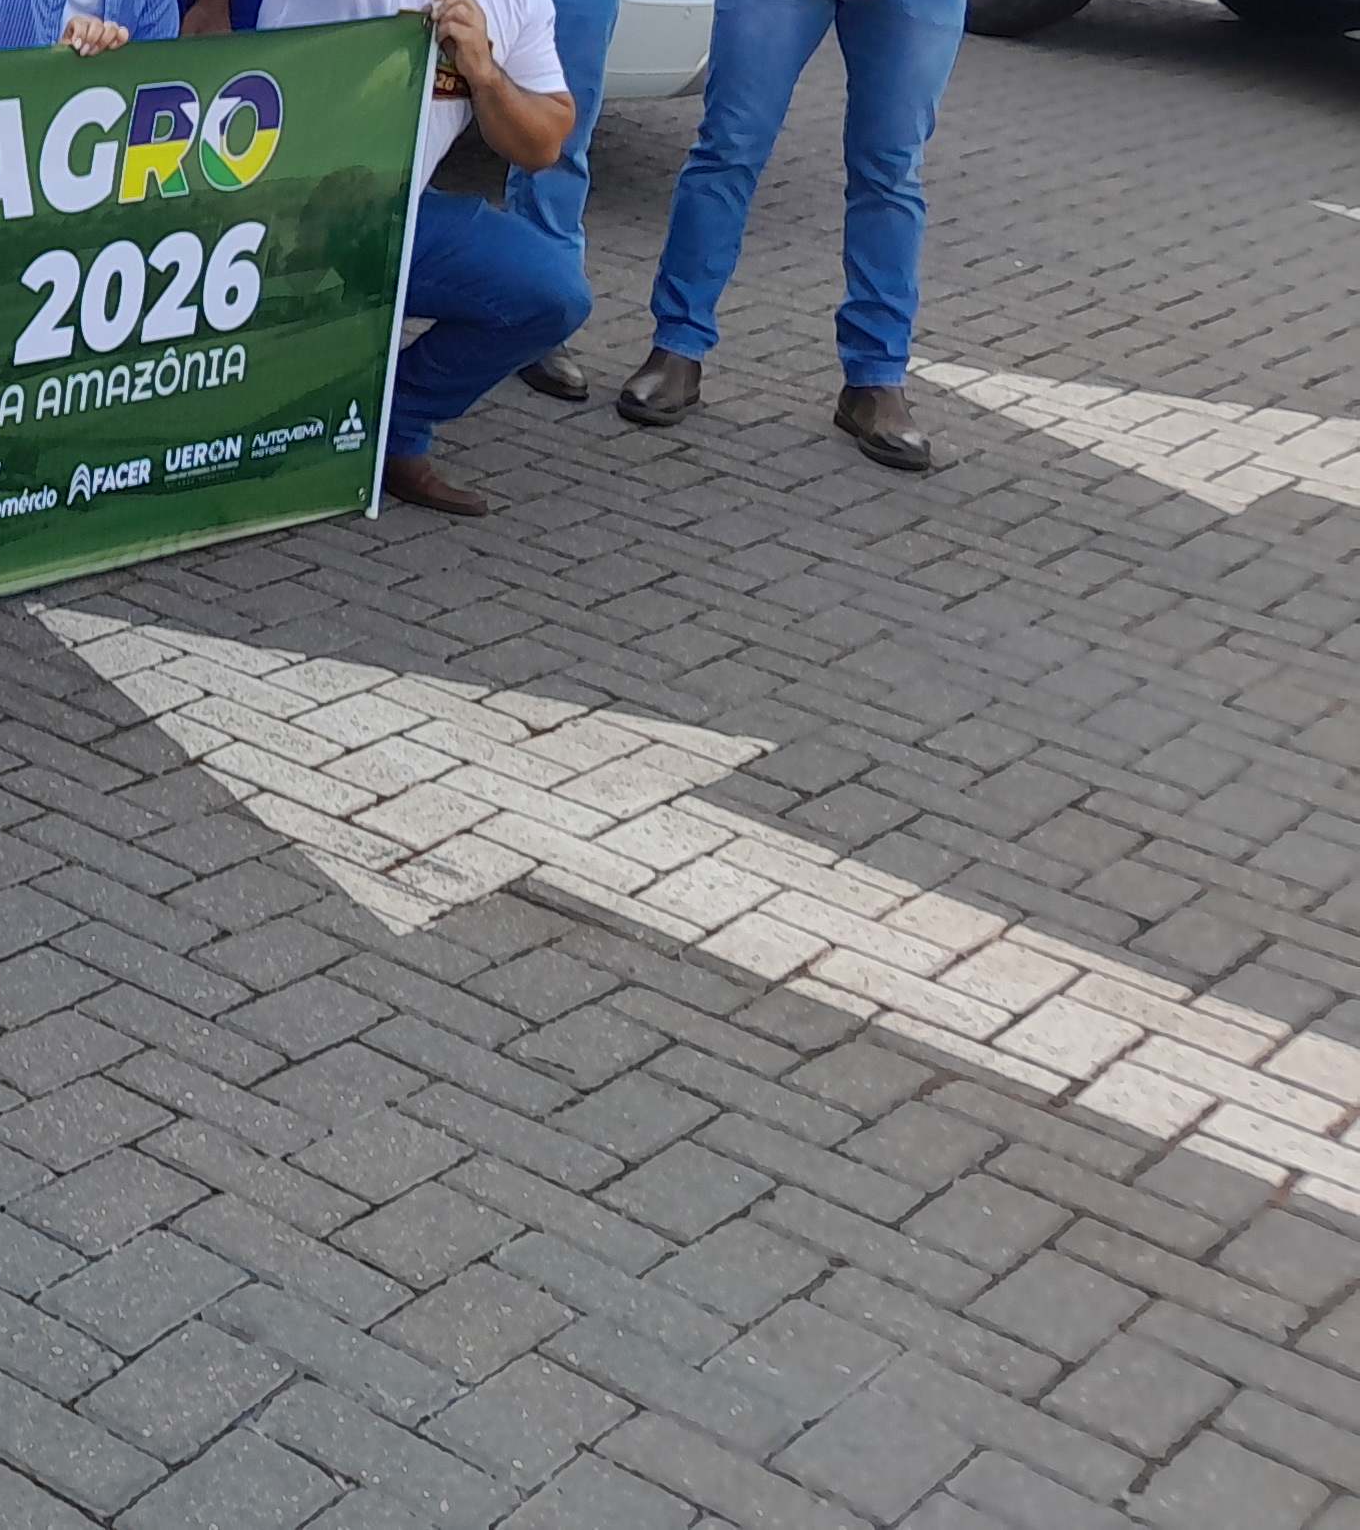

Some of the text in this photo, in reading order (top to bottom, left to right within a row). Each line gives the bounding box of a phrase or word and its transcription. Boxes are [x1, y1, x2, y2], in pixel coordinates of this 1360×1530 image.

[12, 220, 267, 366] 2026
[36, 344, 247, 420] AMAZÔNIA
[251, 419, 325, 448] AUTOVEMA
[92, 457, 152, 495] FACER
